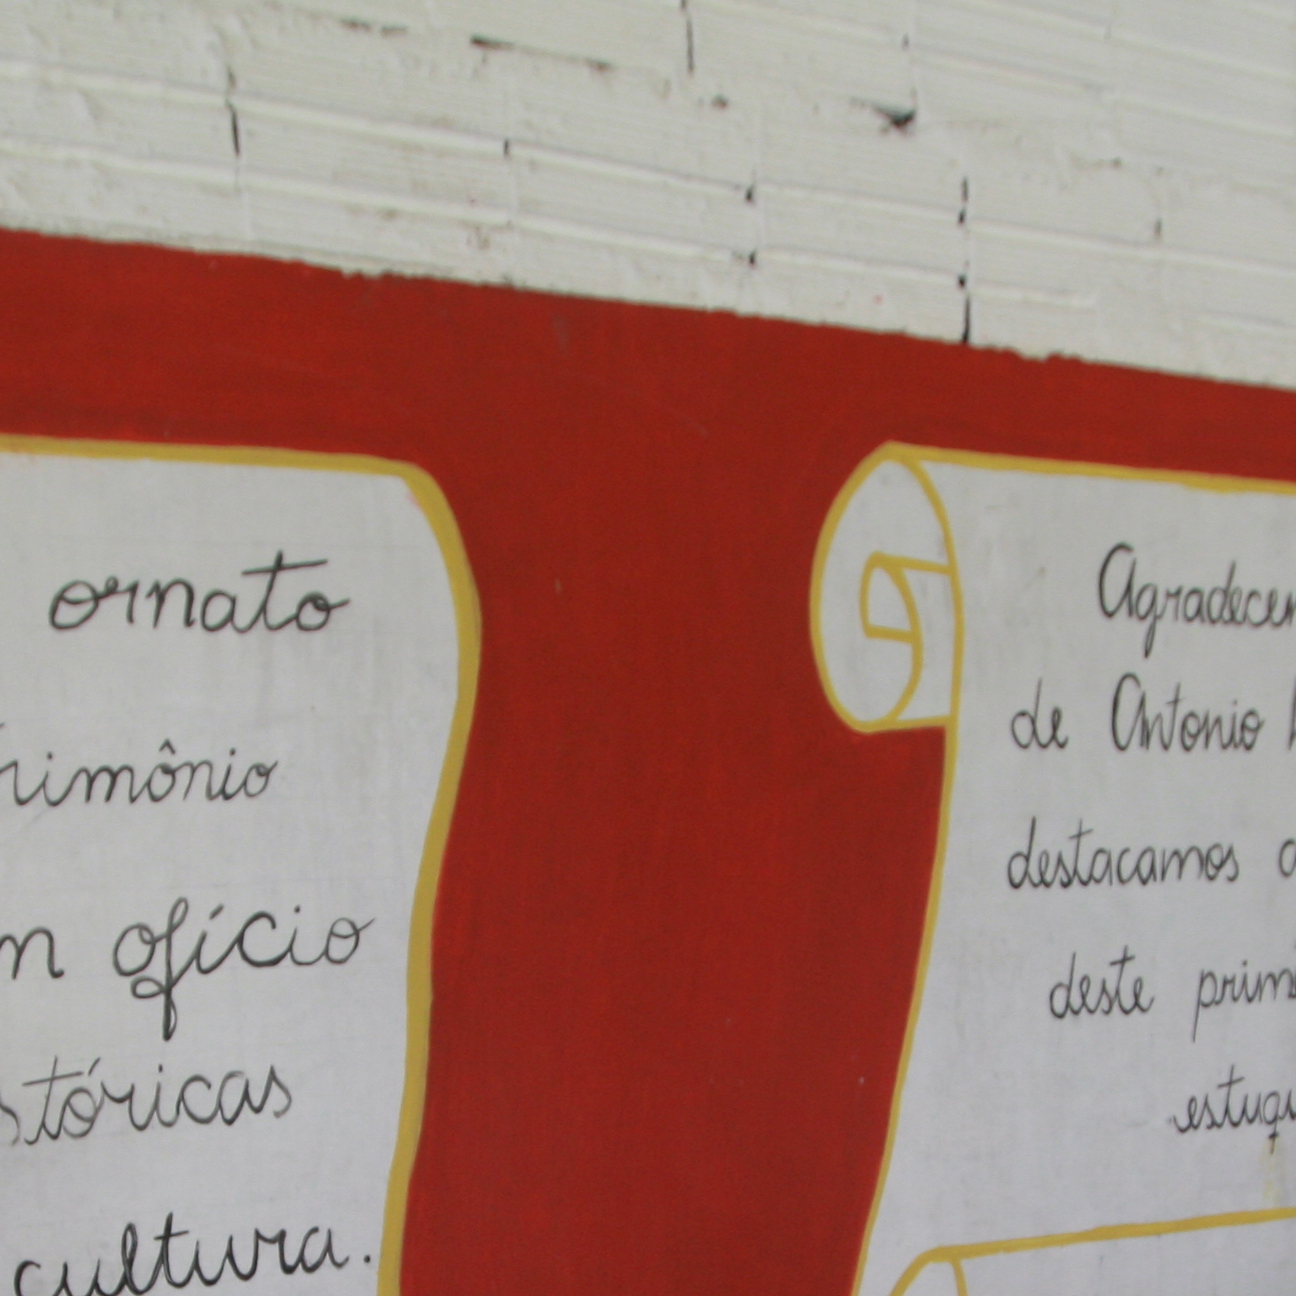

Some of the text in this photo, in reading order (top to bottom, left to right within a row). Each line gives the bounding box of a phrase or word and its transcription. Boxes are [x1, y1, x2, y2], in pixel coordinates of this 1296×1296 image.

[48, 550, 350, 635] ornato
[1010, 680, 1069, 751] de
[1110, 672, 1264, 753] Antonio
[1006, 816, 1239, 891] destacamos
[112, 897, 373, 1042] ofício
[1048, 946, 1154, 1021] deste
